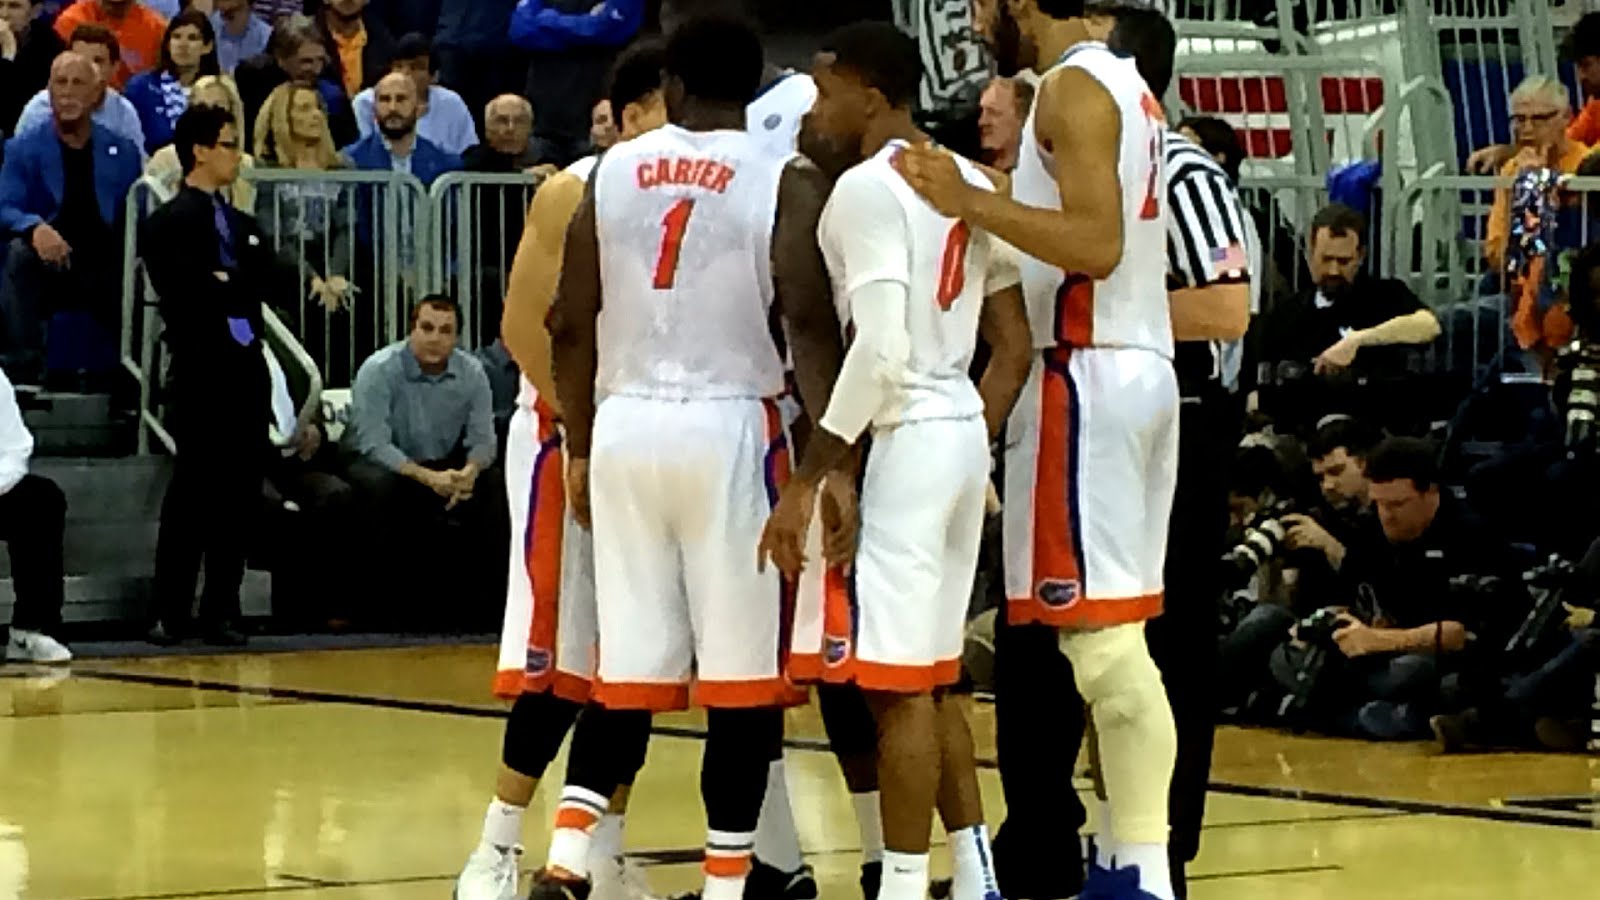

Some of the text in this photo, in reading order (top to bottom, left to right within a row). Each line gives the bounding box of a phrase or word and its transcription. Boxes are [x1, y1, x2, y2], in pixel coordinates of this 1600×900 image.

[636, 157, 736, 195] CARTER
[653, 198, 696, 290] 1
[936, 218, 971, 312] 0
